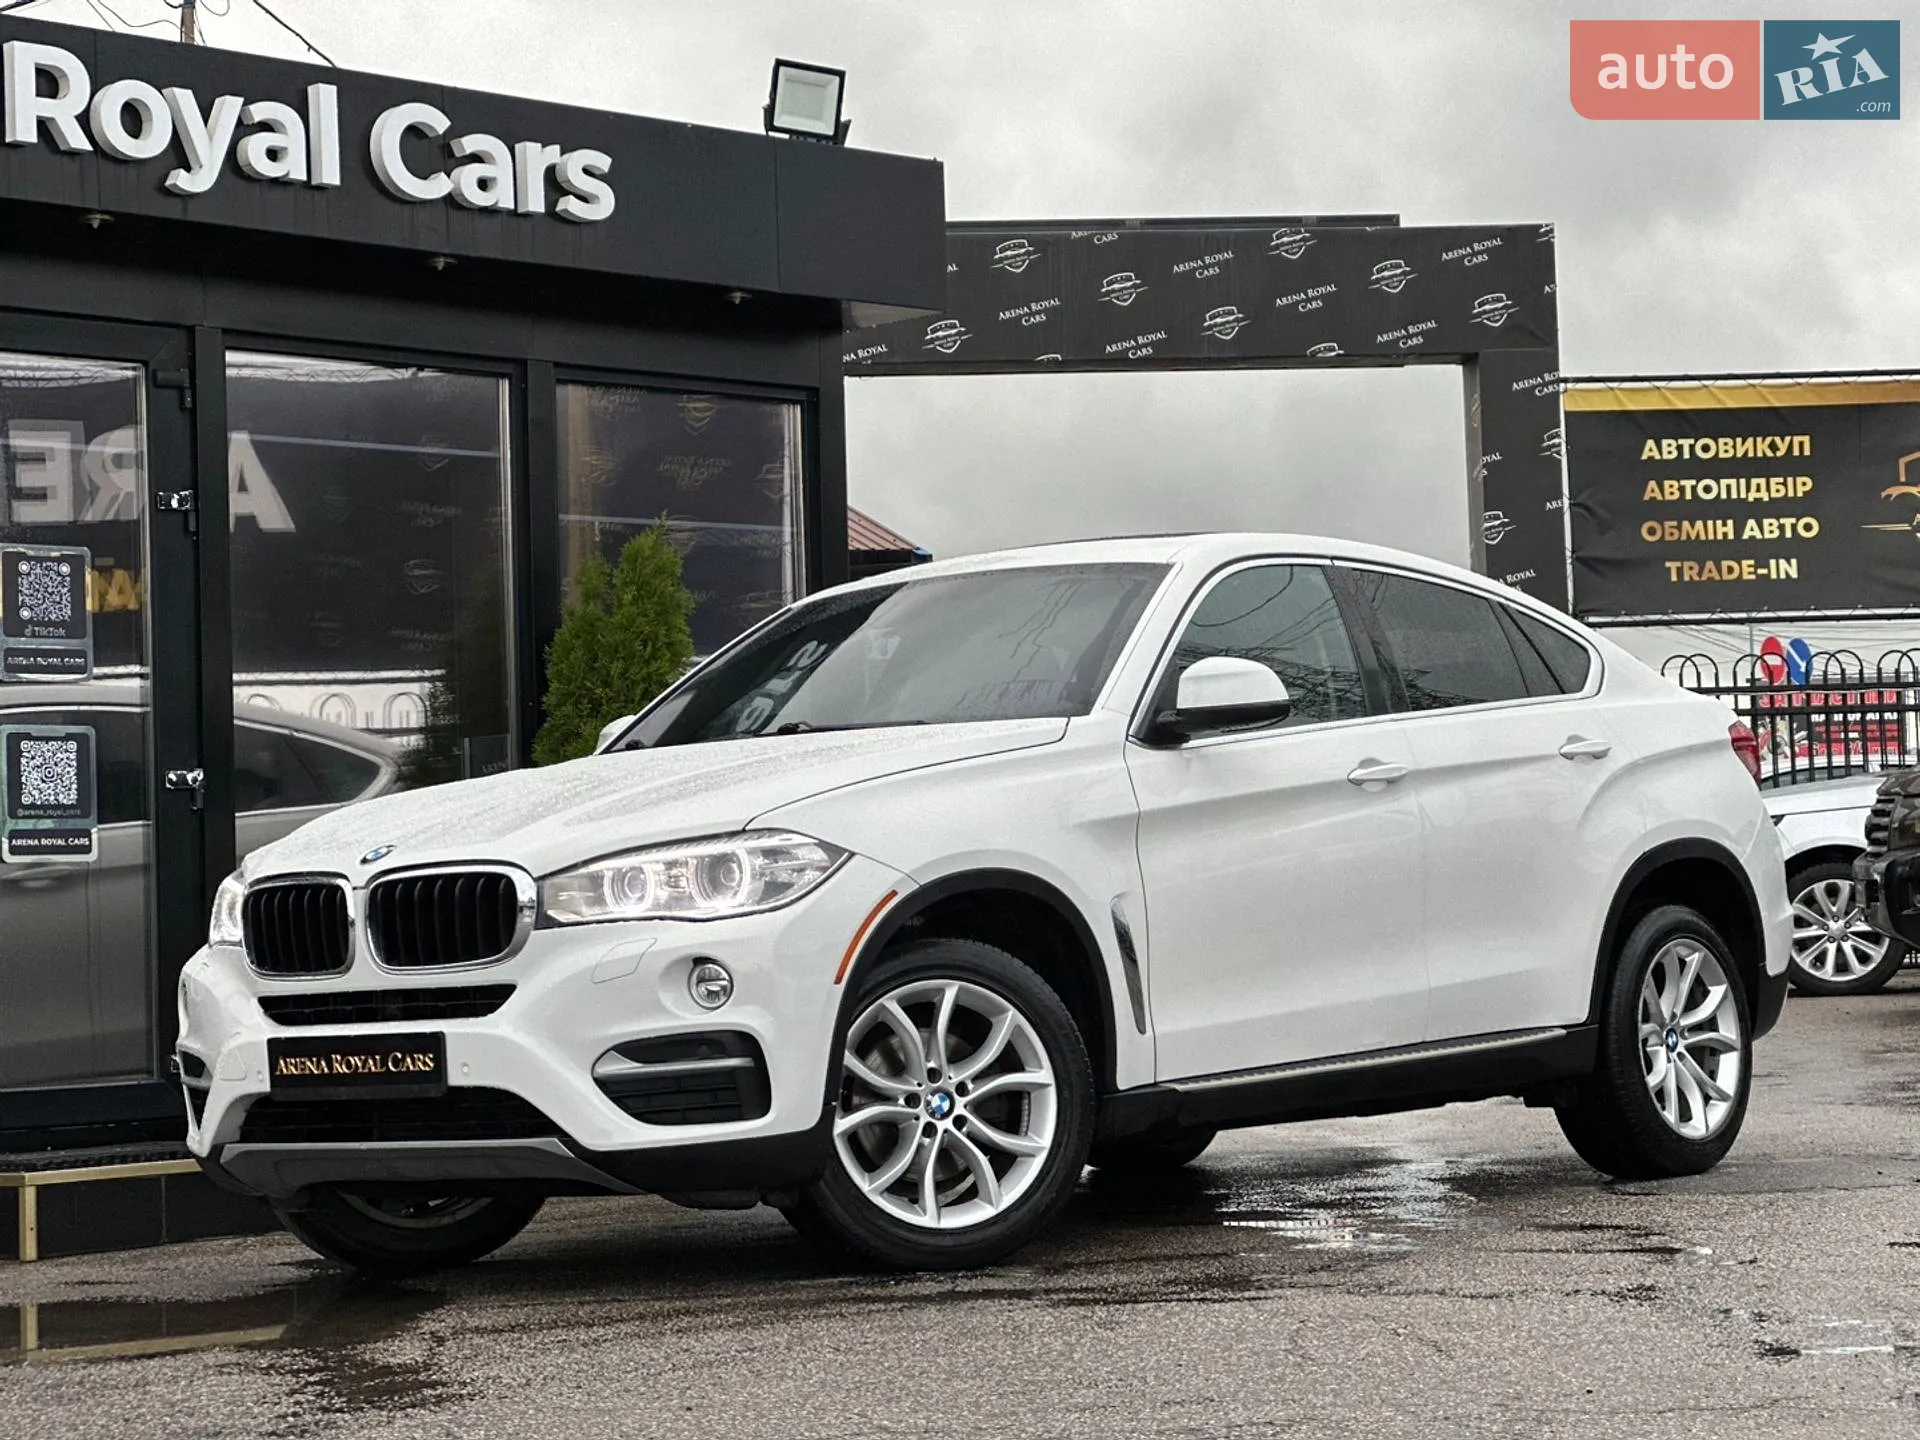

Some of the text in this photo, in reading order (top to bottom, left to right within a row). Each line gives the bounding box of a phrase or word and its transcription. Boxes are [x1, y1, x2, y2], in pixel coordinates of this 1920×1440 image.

[2, 40, 616, 222] Royal Cars
[1441, 237, 1503, 261] ARENA ROYAL
[1464, 253, 1488, 266] CARS
[1173, 250, 1234, 274] ARENA ROYAL
[1195, 266, 1220, 279] CARS
[1275, 283, 1337, 307] ARENA ROYAL
[1299, 299, 1323, 312] CARS
[999, 297, 1060, 321] ARENA ROYAL
[1022, 313, 1047, 326] CARS
[1105, 330, 1167, 354] ARENA ROYAL
[1377, 319, 1438, 343] ARENA ROYAL
[1399, 335, 1424, 349] CARS
[858, 344, 888, 358] ROYAL
[1128, 345, 1153, 359] CARS
[1512, 376, 1542, 391] ARENA
[1535, 383, 1560, 396] CARS
[1641, 435, 1810, 460] АВТОВИКУП
[1644, 476, 1813, 501] АВТОПІДБІР
[1641, 517, 1819, 542] ОБМІН АВТО
[1507, 569, 1536, 583] ROYAL
[1665, 558, 1798, 582] TRADE-IN
[275, 1051, 434, 1075] ARENA ROYAL CARS
